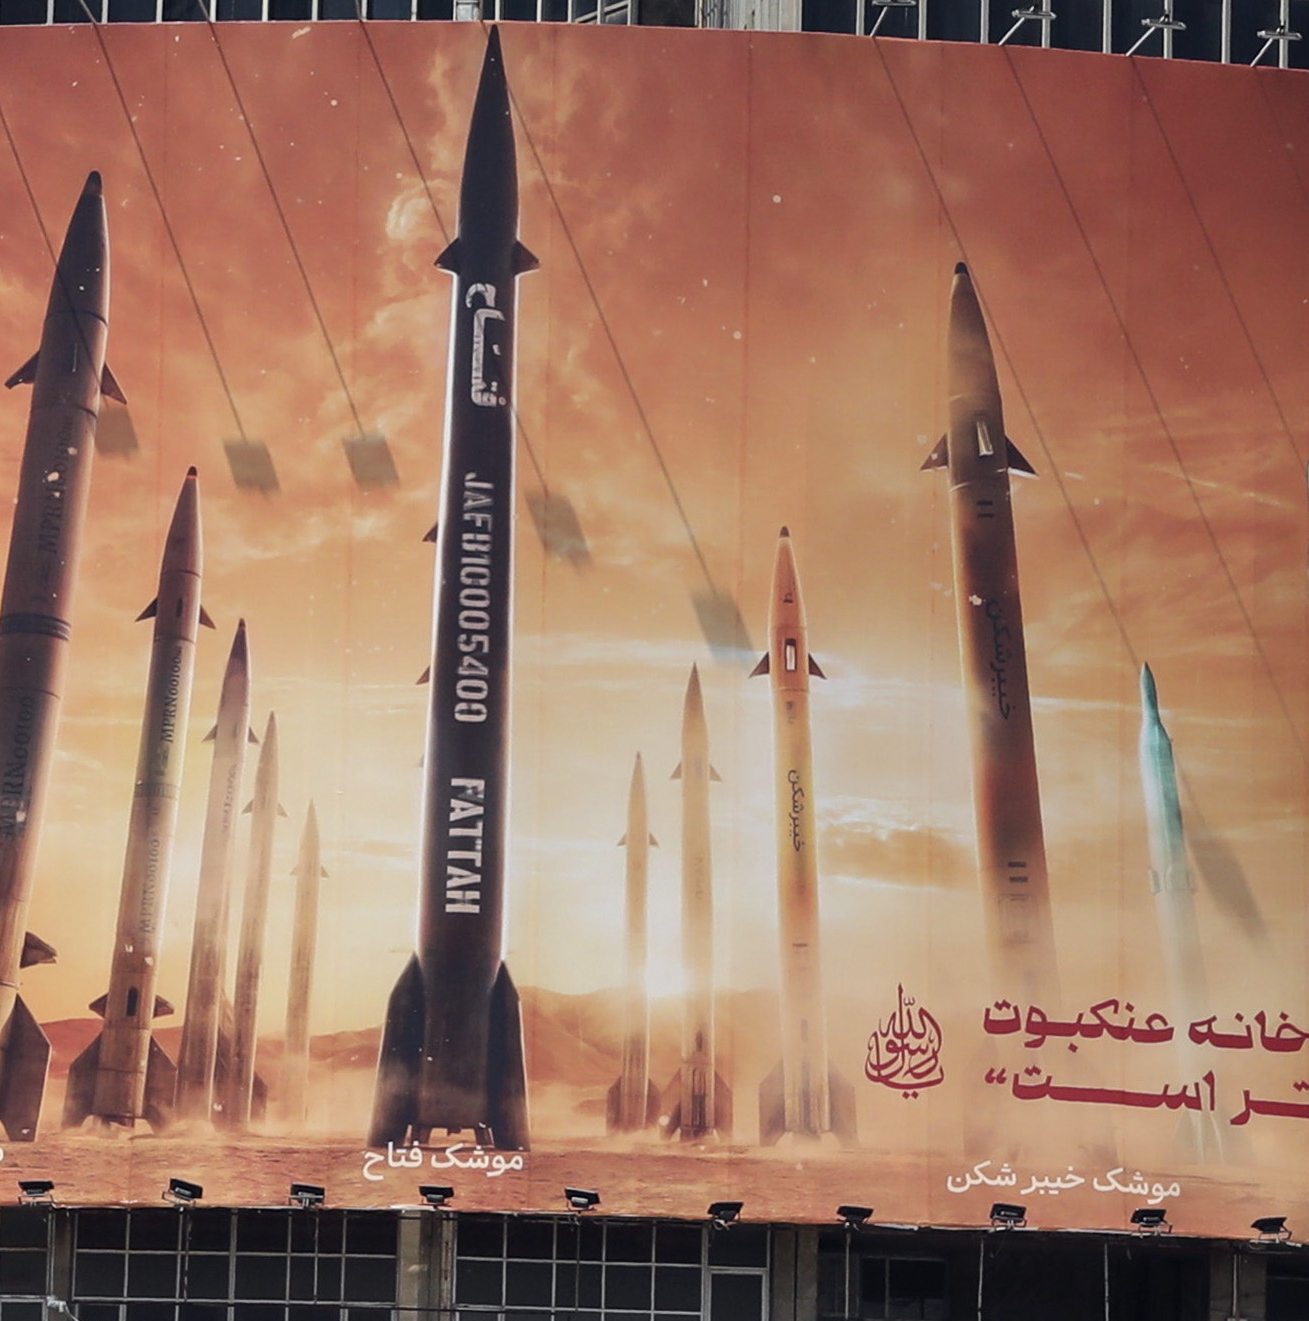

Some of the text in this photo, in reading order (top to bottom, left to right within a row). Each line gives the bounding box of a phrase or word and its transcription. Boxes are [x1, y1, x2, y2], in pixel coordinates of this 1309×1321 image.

[445, 778, 486, 914] FATTAH
[983, 999, 1175, 1054] عنکبوت
[361, 1142, 524, 1181] موشک فتاح
[946, 1161, 1182, 1204] موشک خیبر شکن
